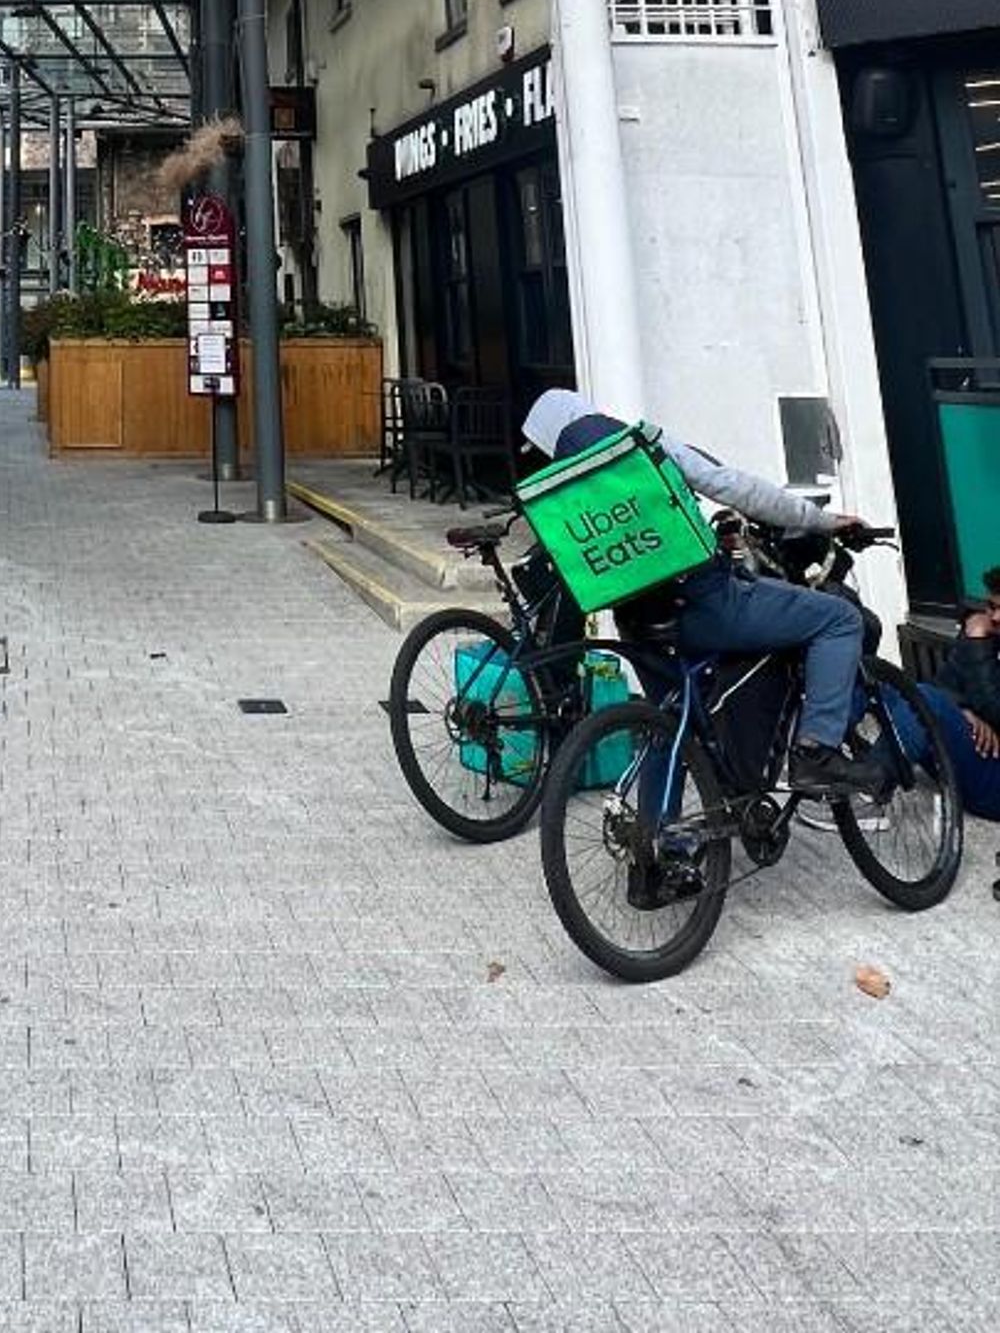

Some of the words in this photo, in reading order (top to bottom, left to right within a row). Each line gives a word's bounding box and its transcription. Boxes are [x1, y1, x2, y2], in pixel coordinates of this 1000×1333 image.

[454, 90, 498, 157] FRIES
[564, 495, 641, 545] Uber
[582, 527, 662, 577] Eats
